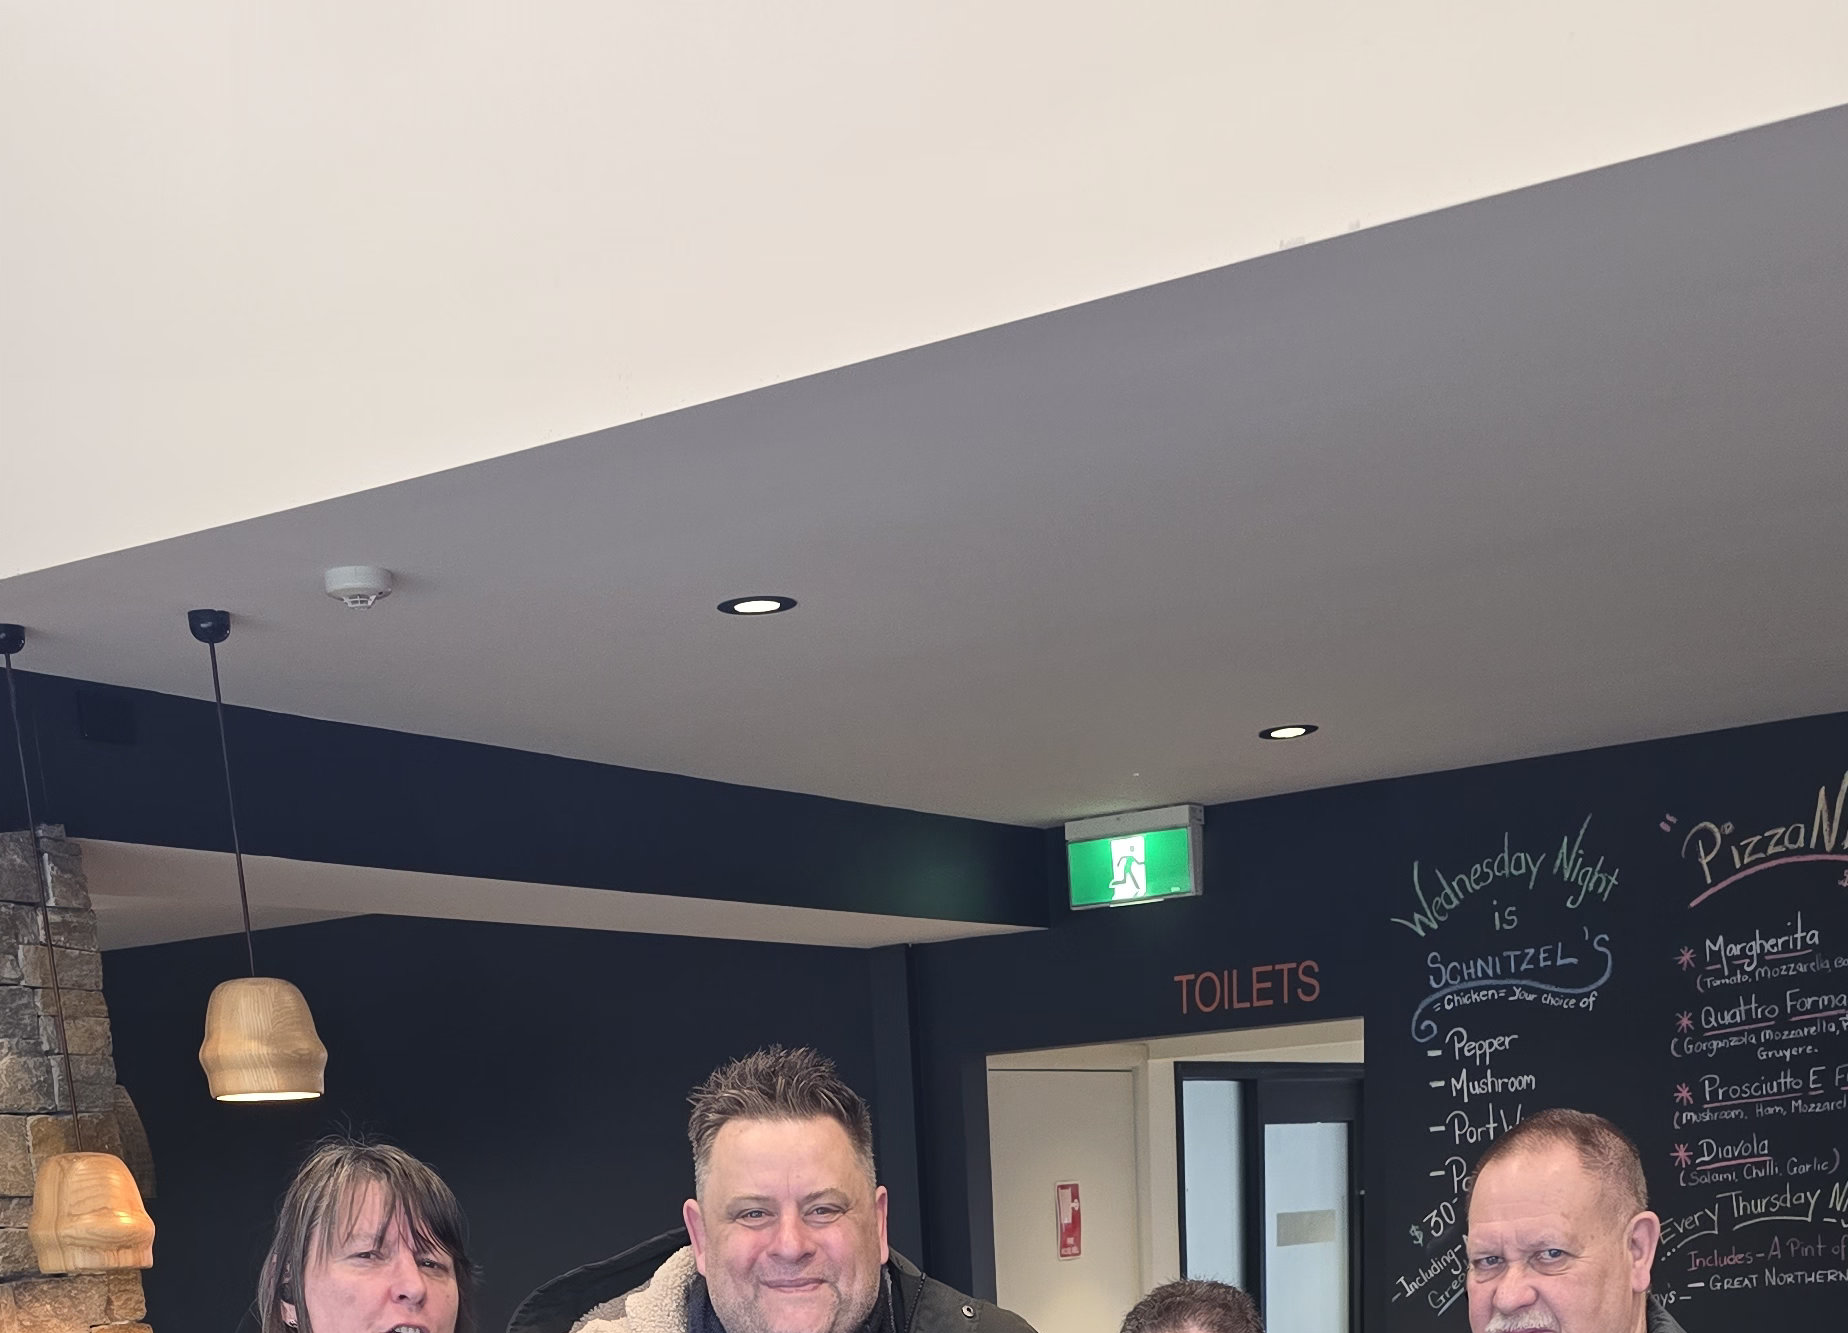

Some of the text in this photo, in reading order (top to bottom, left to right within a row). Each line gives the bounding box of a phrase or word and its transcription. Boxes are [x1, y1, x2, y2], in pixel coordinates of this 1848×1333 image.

[1809, 769, 1848, 853] N
[1391, 813, 1619, 937] Wednesday Night
[1493, 900, 1518, 930] is
[1705, 911, 1819, 976] Margherita
[1174, 960, 1320, 1014] TOILETS
[1508, 986, 1537, 1001] Your
[1541, 990, 1576, 1009] choice
[1579, 991, 1598, 1011] of
[1701, 989, 1848, 1029] Quattro Forma
[1445, 1027, 1518, 1066] Pepper
[1451, 1068, 1536, 1102] Mushroom
[1699, 1068, 1803, 1102] Prosciutto
[1809, 1066, 1826, 1089] E
[1791, 1093, 1848, 1113] Mozzarel
[1445, 1102, 1498, 1145] Port
[1696, 1132, 1769, 1163] Diavola
[1659, 1203, 1719, 1245] Every
[1716, 1182, 1821, 1223] Thursday
[1786, 1234, 1827, 1258] Pint
[1831, 1234, 1848, 1261] of
[1709, 1266, 1848, 1291] GREAT NORTHERN
